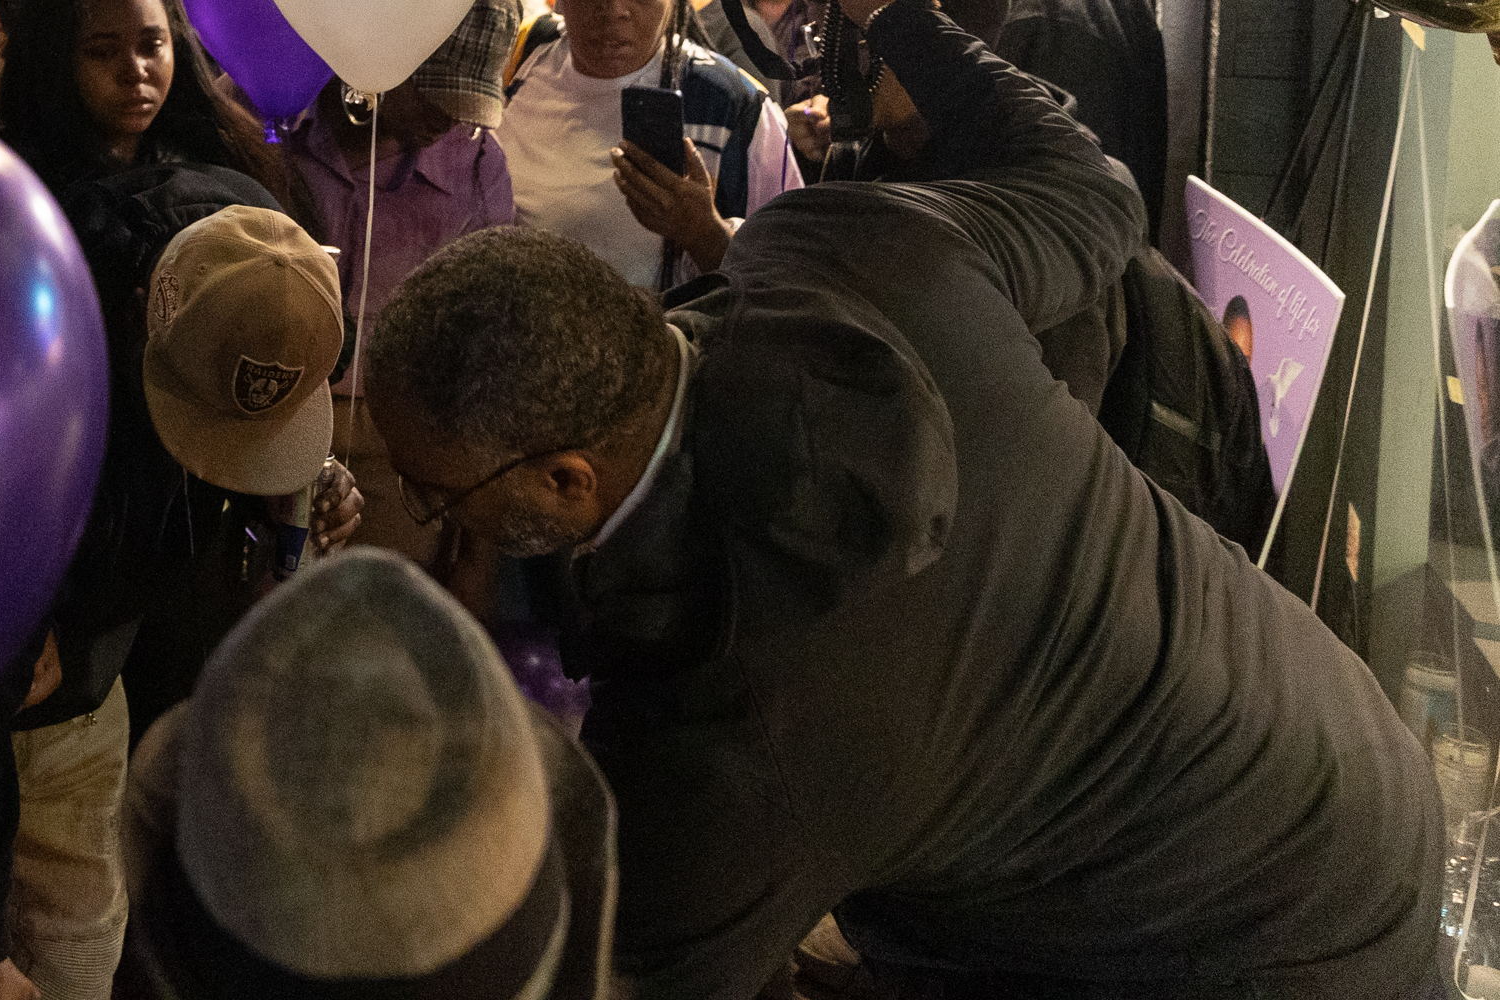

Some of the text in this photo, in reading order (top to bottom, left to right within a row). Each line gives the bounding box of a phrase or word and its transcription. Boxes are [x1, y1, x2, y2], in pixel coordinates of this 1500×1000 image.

[1218, 228, 1279, 297] Celebration
[1276, 284, 1296, 319] of
[1298, 305, 1321, 341] for
[246, 363, 296, 380] RAIDERS
